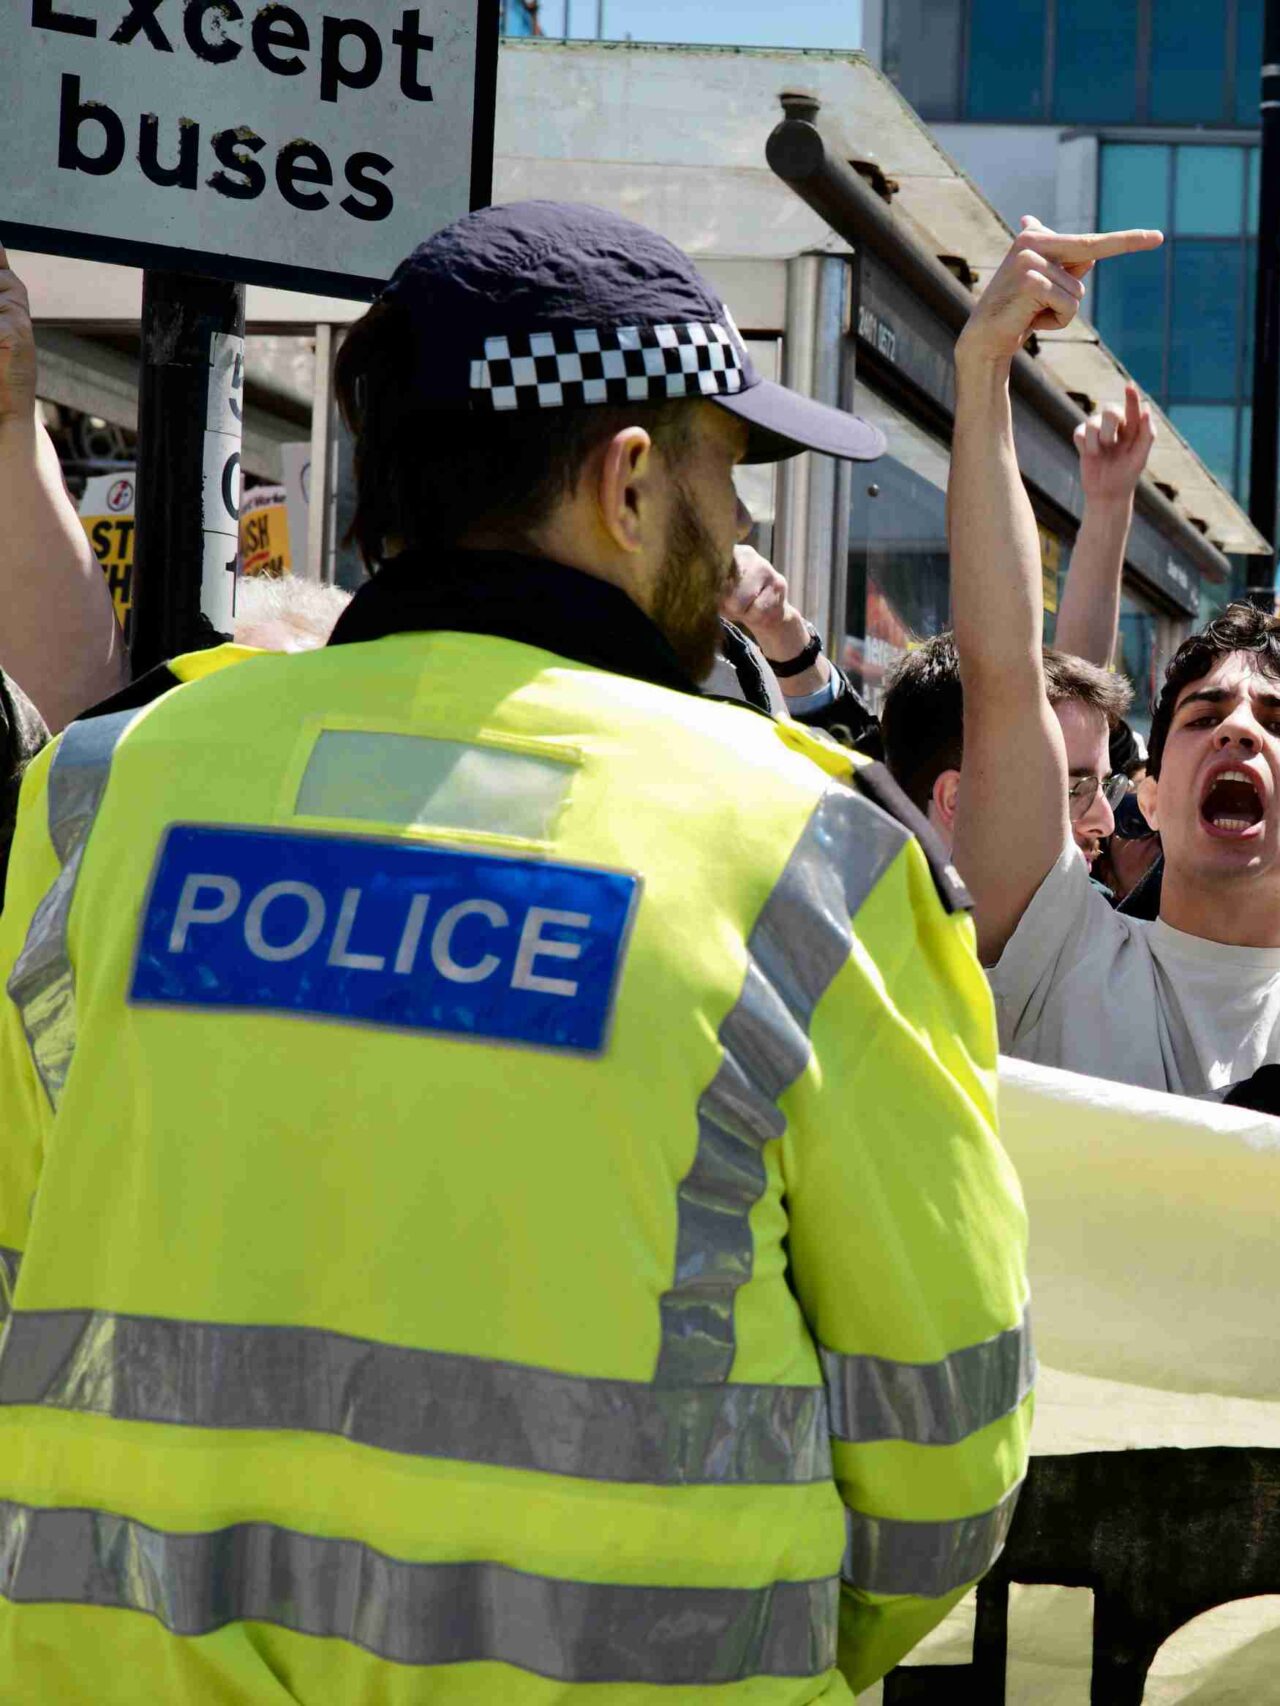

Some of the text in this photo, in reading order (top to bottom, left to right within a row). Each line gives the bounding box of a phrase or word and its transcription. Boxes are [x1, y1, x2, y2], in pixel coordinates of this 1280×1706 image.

[57, 73, 395, 222] buses
[91, 520, 135, 560] ST
[167, 872, 592, 998] POLICE
